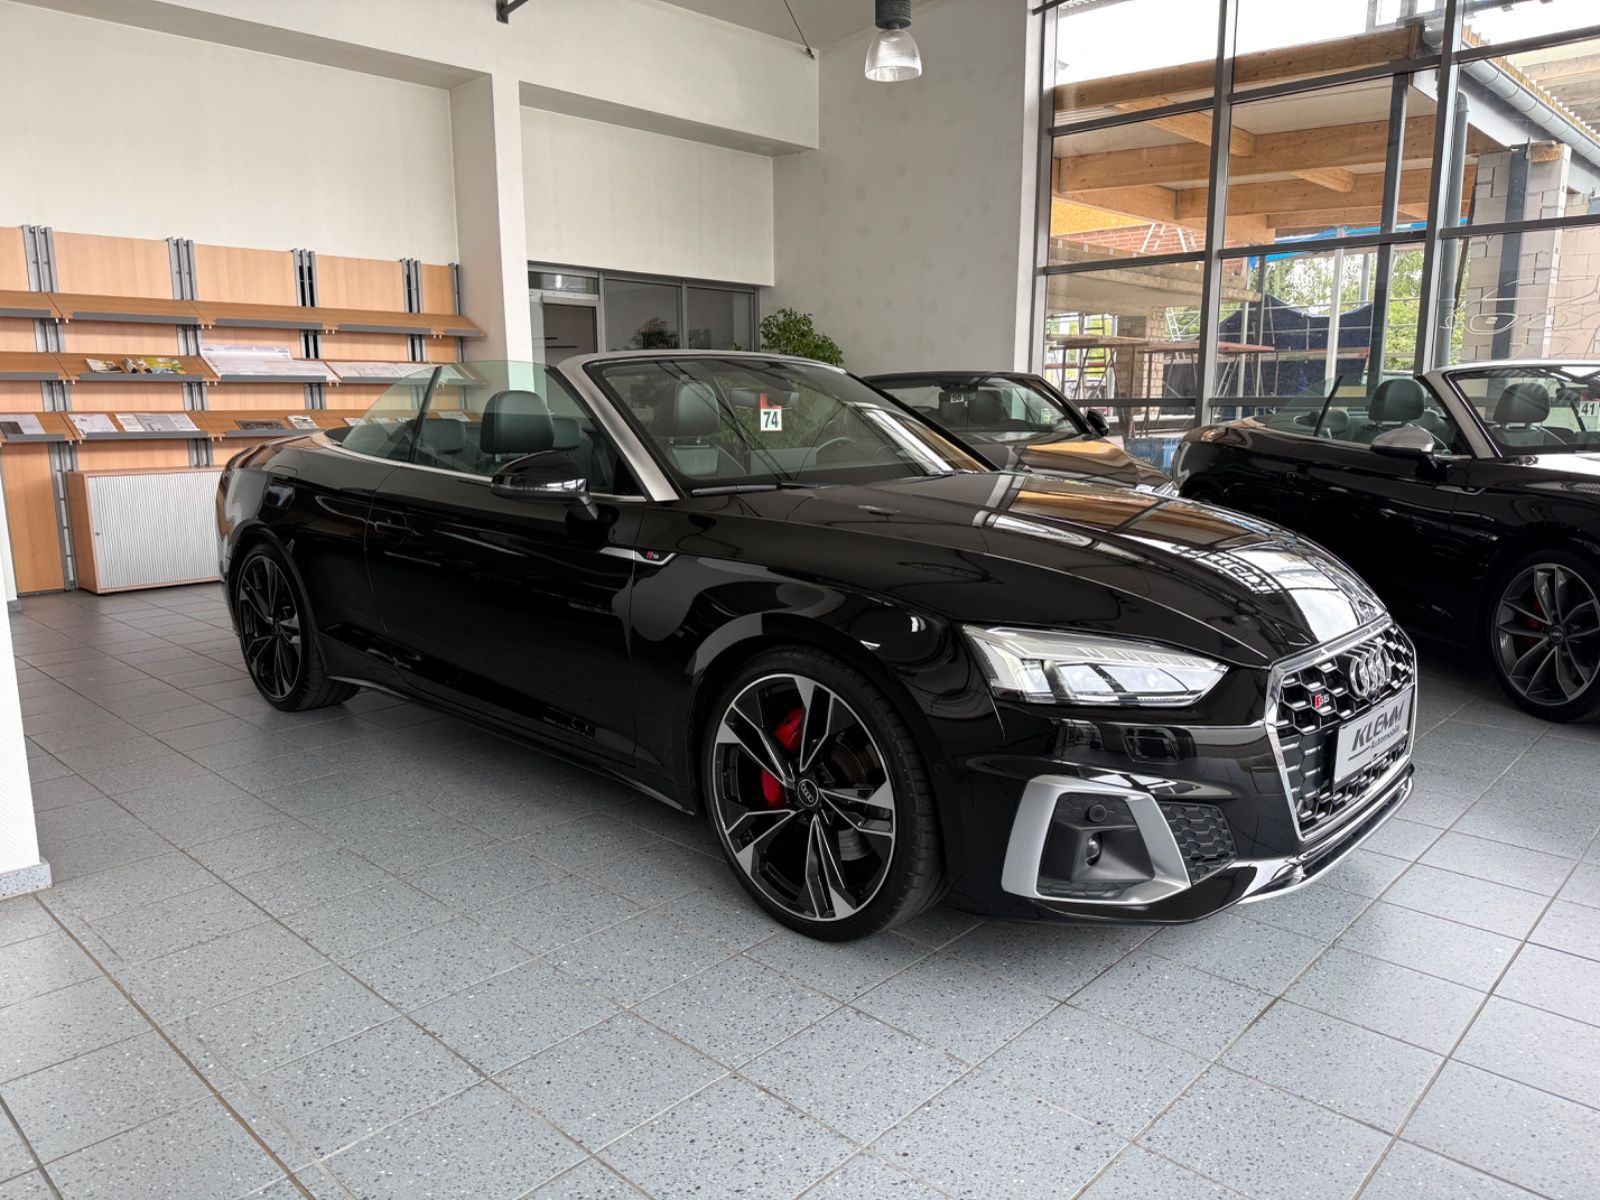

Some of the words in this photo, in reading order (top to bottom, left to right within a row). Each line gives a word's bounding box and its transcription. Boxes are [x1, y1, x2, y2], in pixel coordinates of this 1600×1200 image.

[1582, 403, 1595, 415] 41
[763, 411, 779, 428] 74
[1351, 700, 1405, 751] KLEMM
